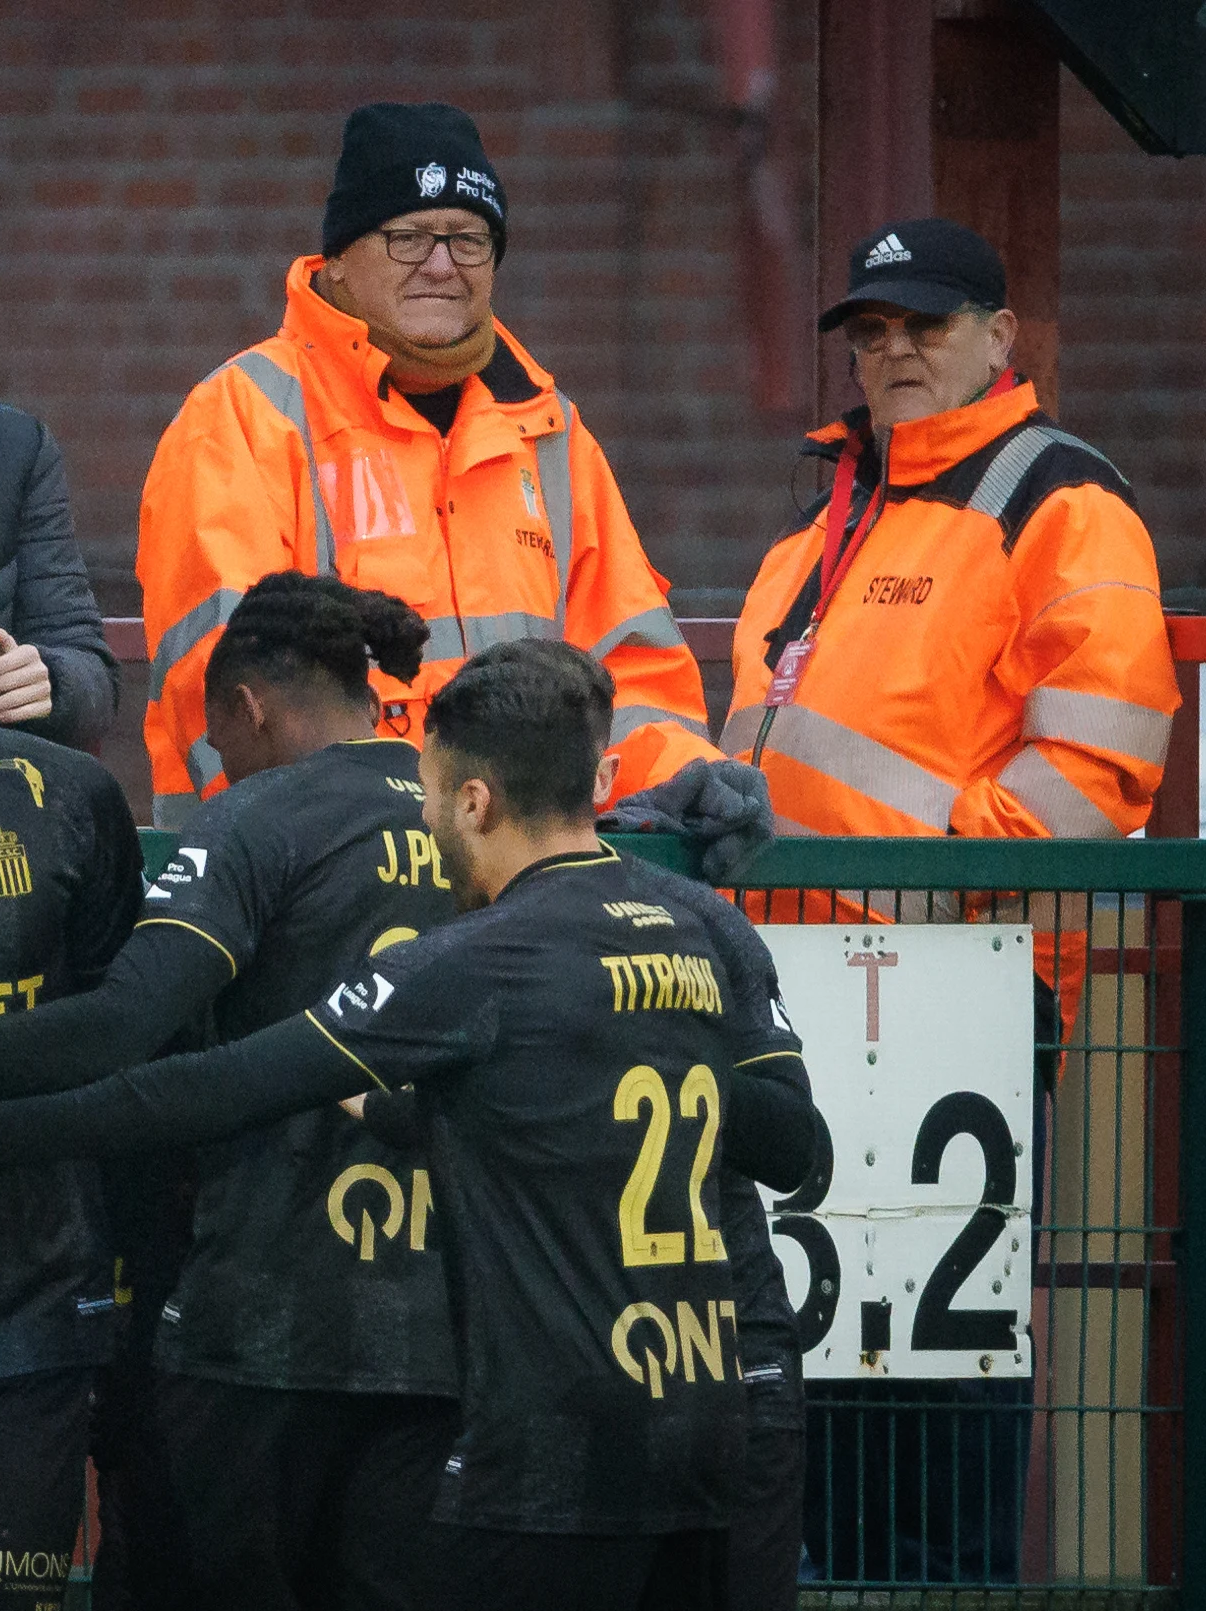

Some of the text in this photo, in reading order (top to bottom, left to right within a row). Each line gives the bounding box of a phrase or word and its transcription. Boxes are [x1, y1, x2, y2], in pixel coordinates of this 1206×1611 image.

[456, 180, 479, 197] Pro
[865, 250, 912, 268] adidas
[167, 862, 185, 873] Pro
[847, 951, 899, 1042] T
[613, 1064, 729, 1267] 22
